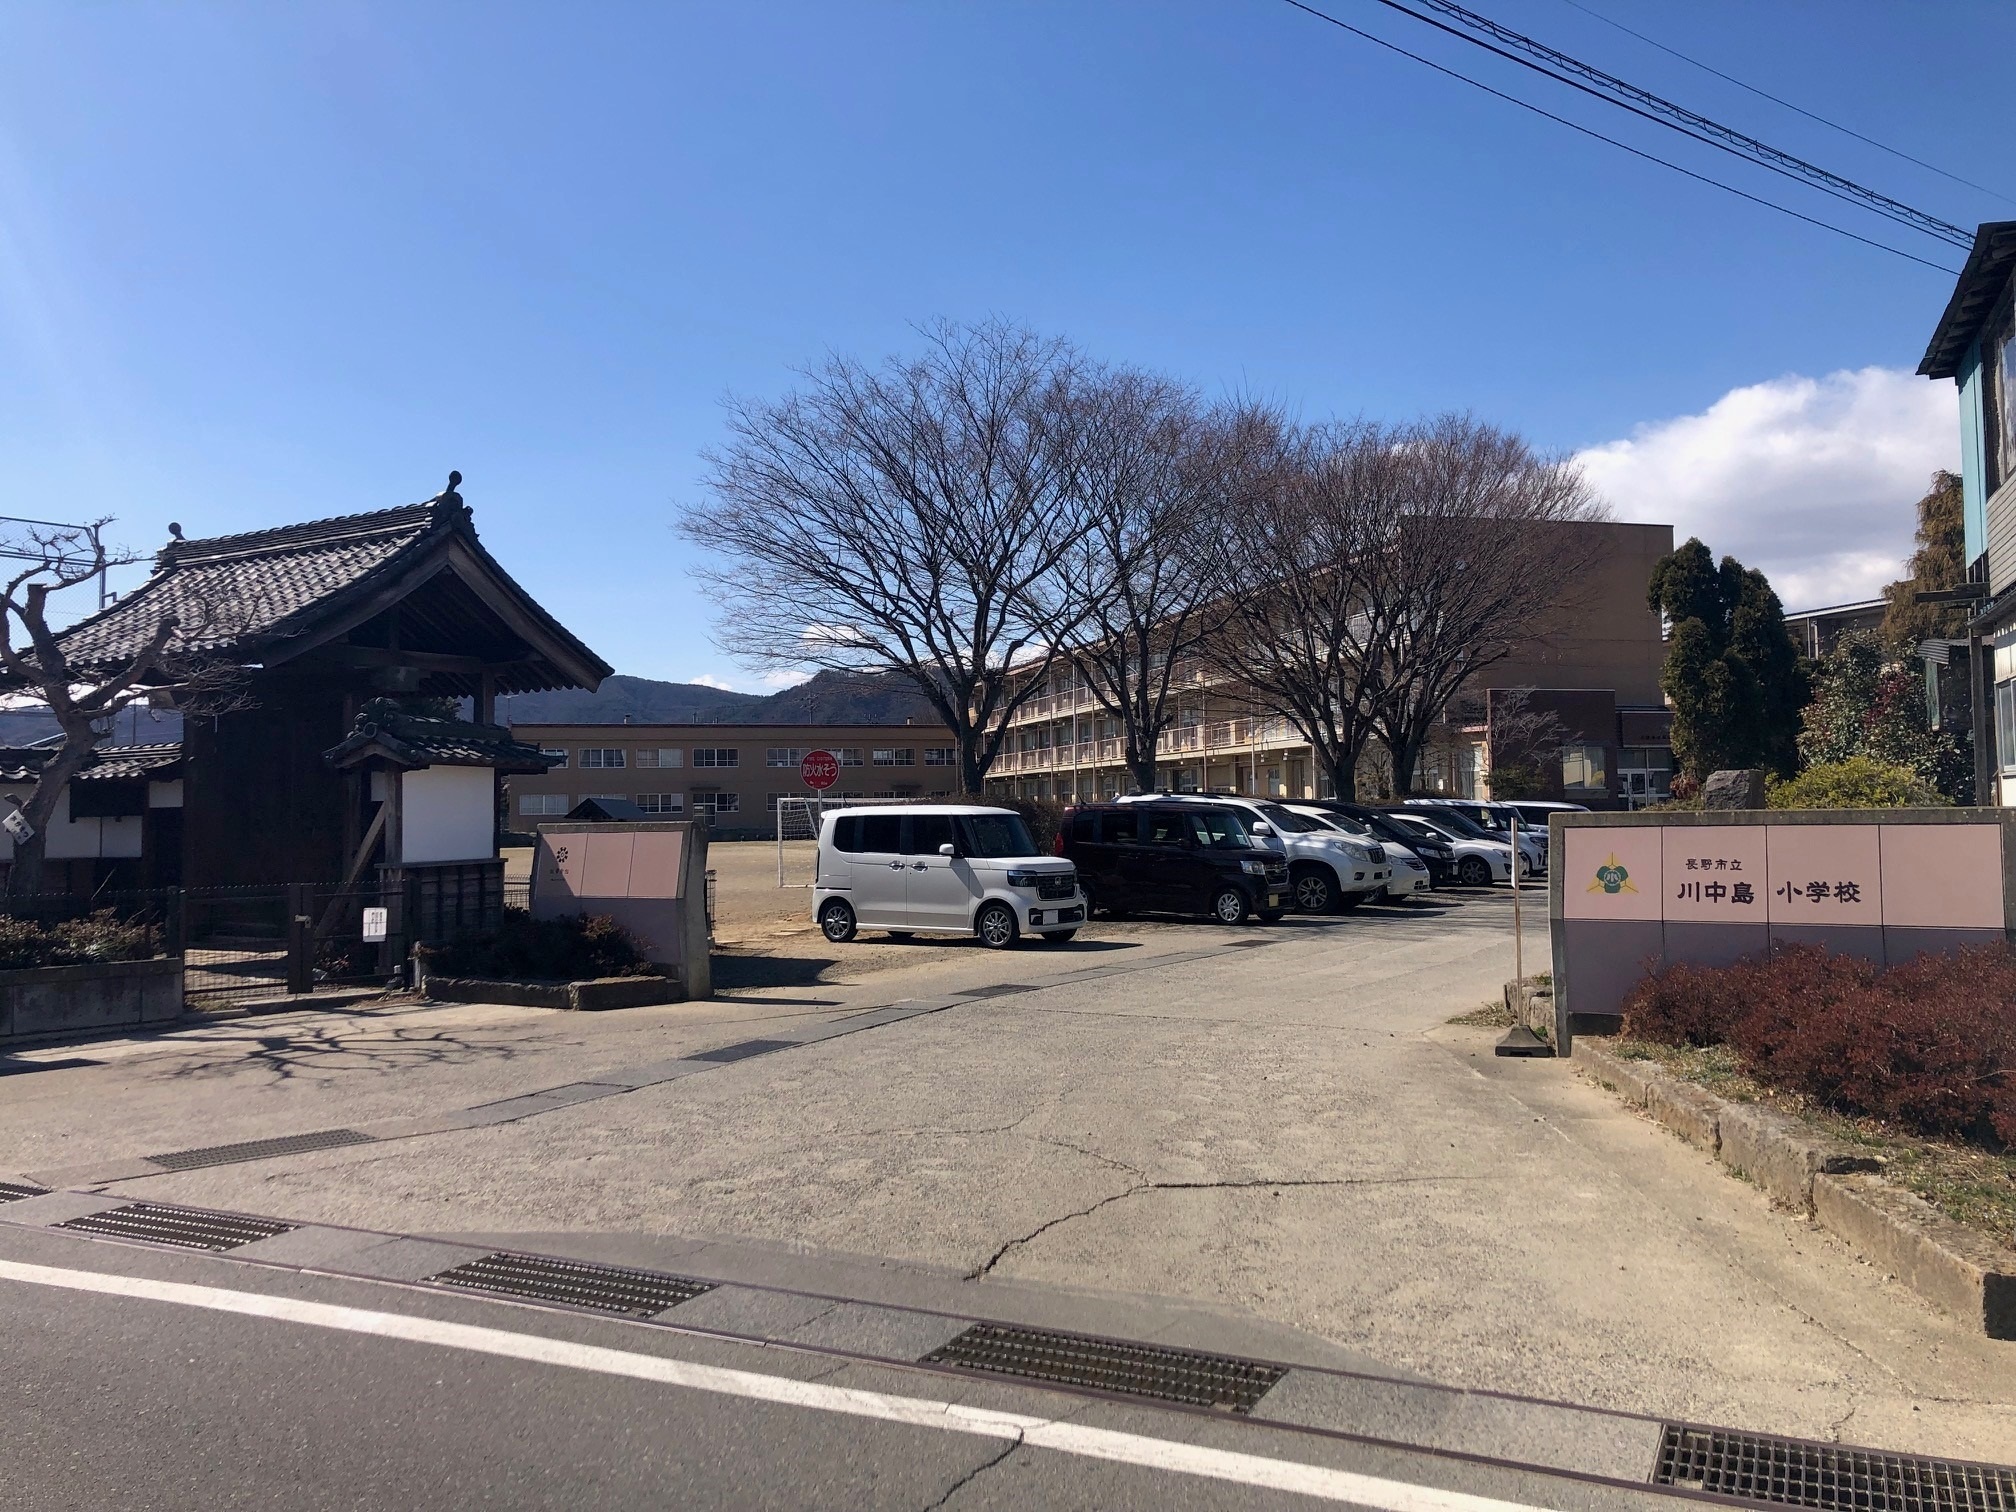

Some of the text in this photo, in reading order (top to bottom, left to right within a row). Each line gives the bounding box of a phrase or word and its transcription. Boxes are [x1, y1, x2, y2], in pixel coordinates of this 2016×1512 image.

[803, 763, 837, 777] 防火水そう
[1686, 858, 1743, 871] 長野市立
[1677, 881, 1861, 904] 川中島 小学校
